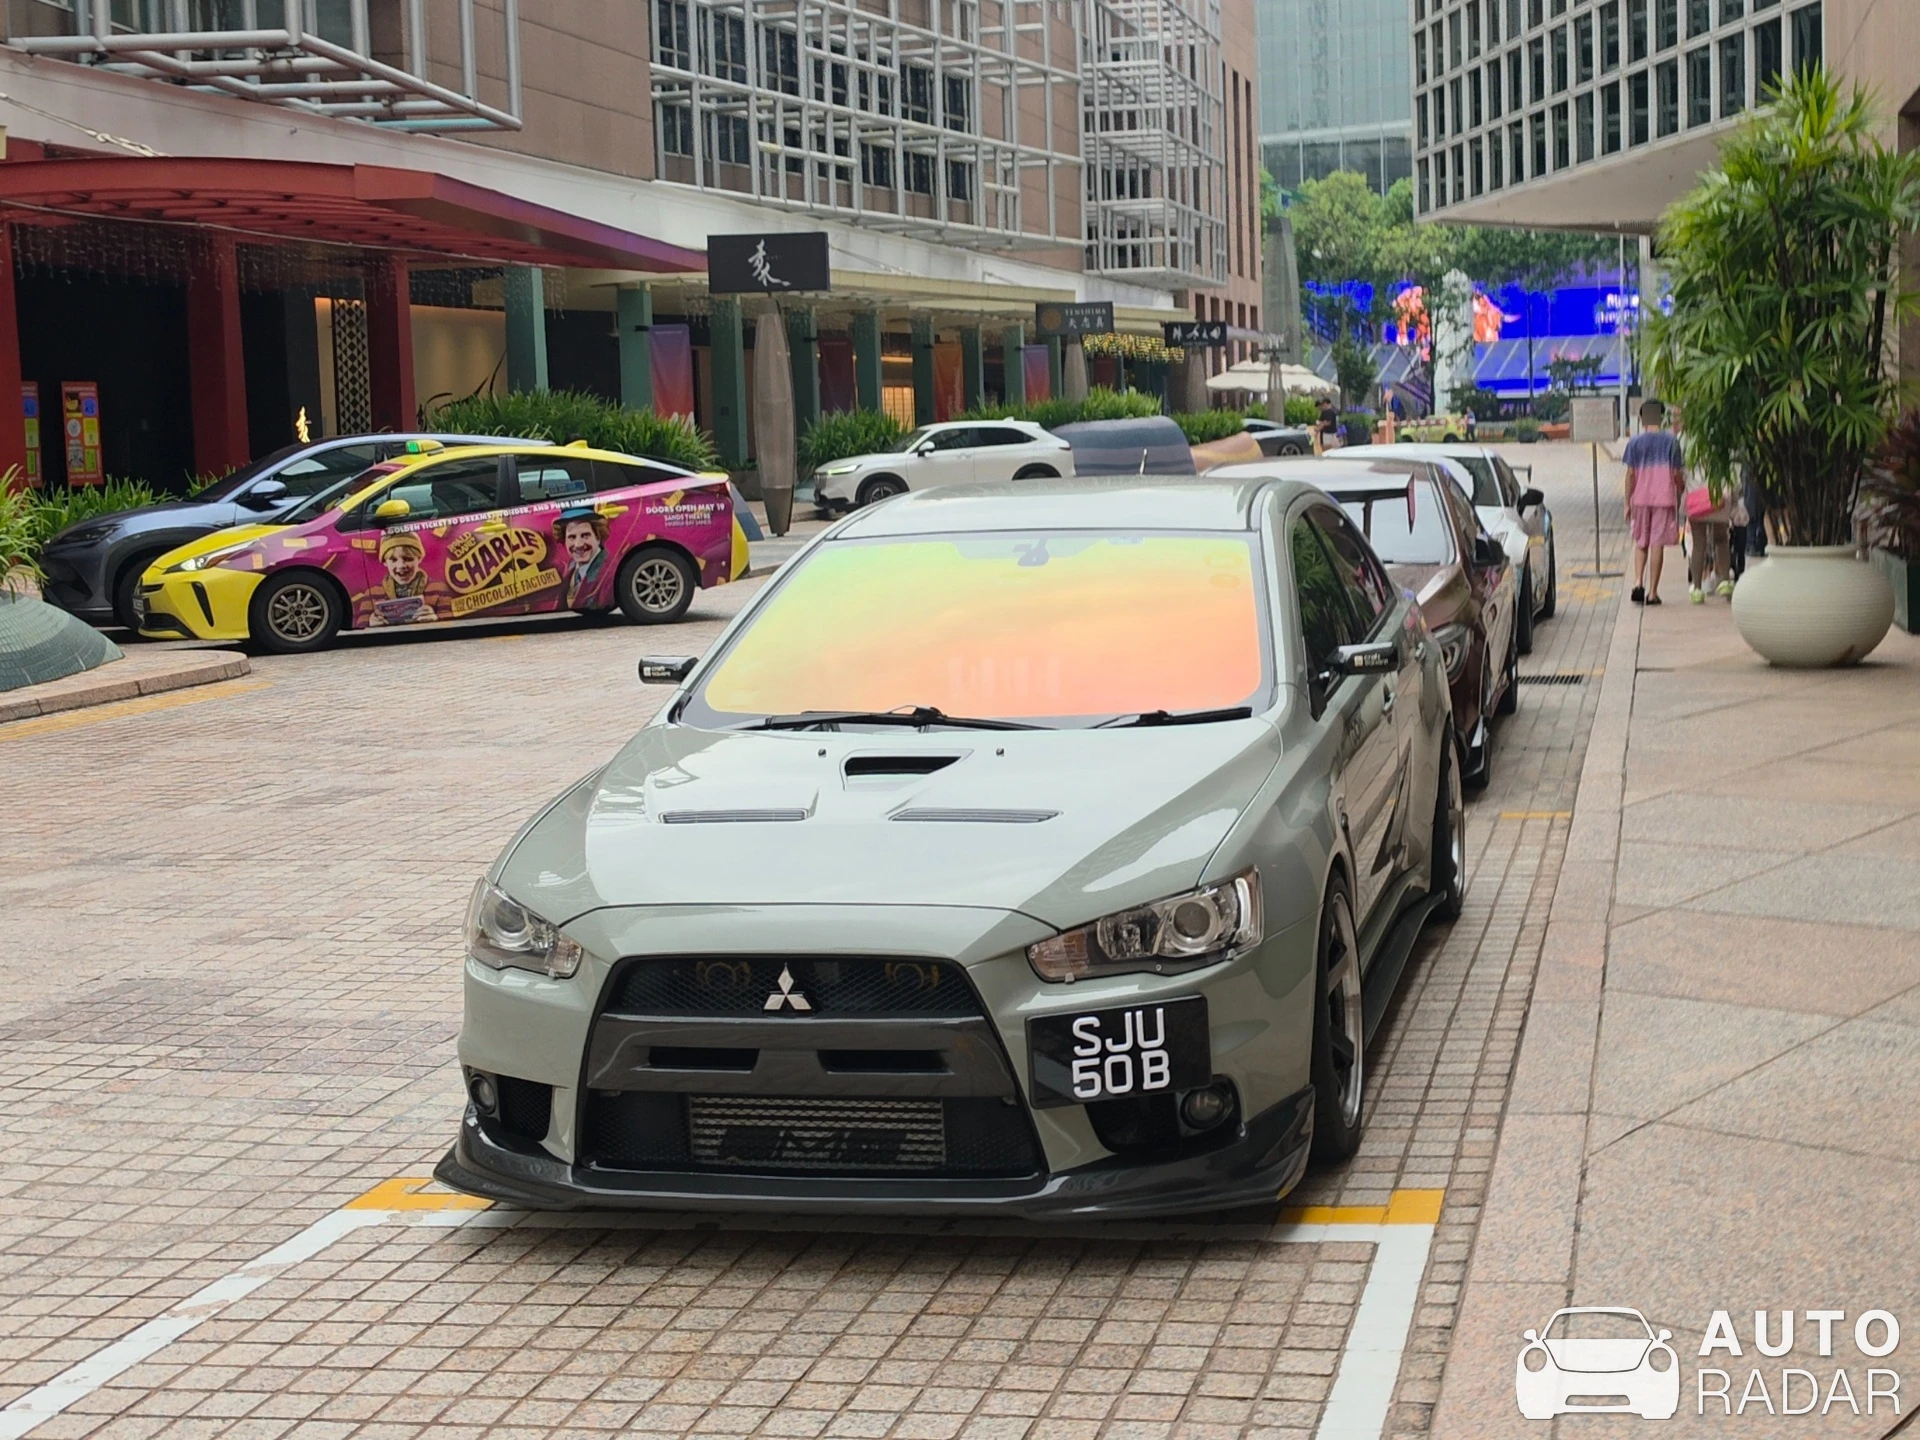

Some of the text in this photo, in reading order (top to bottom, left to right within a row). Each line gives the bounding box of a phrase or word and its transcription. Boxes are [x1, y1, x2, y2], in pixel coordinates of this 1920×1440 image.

[645, 505, 675, 514] DOORS
[675, 504, 697, 512] OPEN
[448, 530, 540, 588] CHARLIE
[465, 571, 557, 609] CHOCOLATE FACTORY
[1072, 1008, 1165, 1057] SJU
